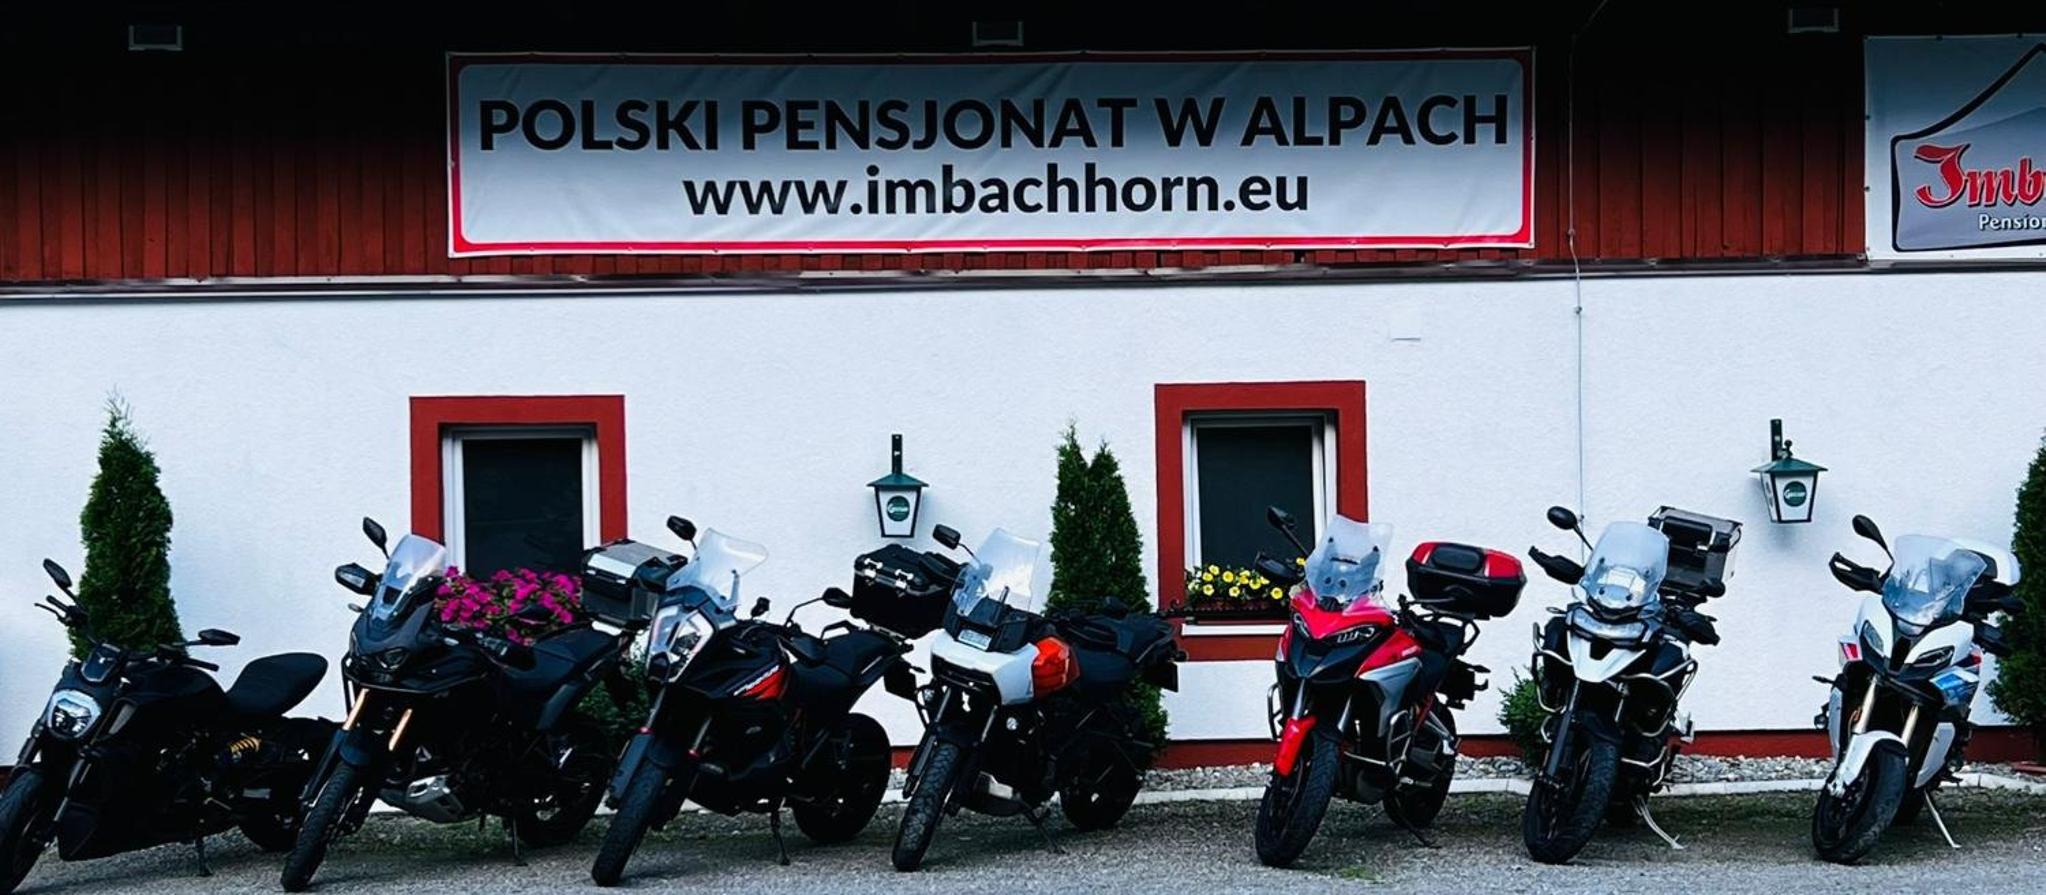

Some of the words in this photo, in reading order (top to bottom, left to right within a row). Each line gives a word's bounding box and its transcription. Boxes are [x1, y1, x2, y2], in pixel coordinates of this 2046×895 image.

[479, 98, 720, 151] POLSKI
[741, 96, 1138, 151] PENSJONAT
[1152, 95, 1226, 148] W
[1240, 93, 1509, 147] ALPACH
[682, 163, 1309, 215] www.imbachhorn.eu
[1914, 144, 2046, 209] Imb
